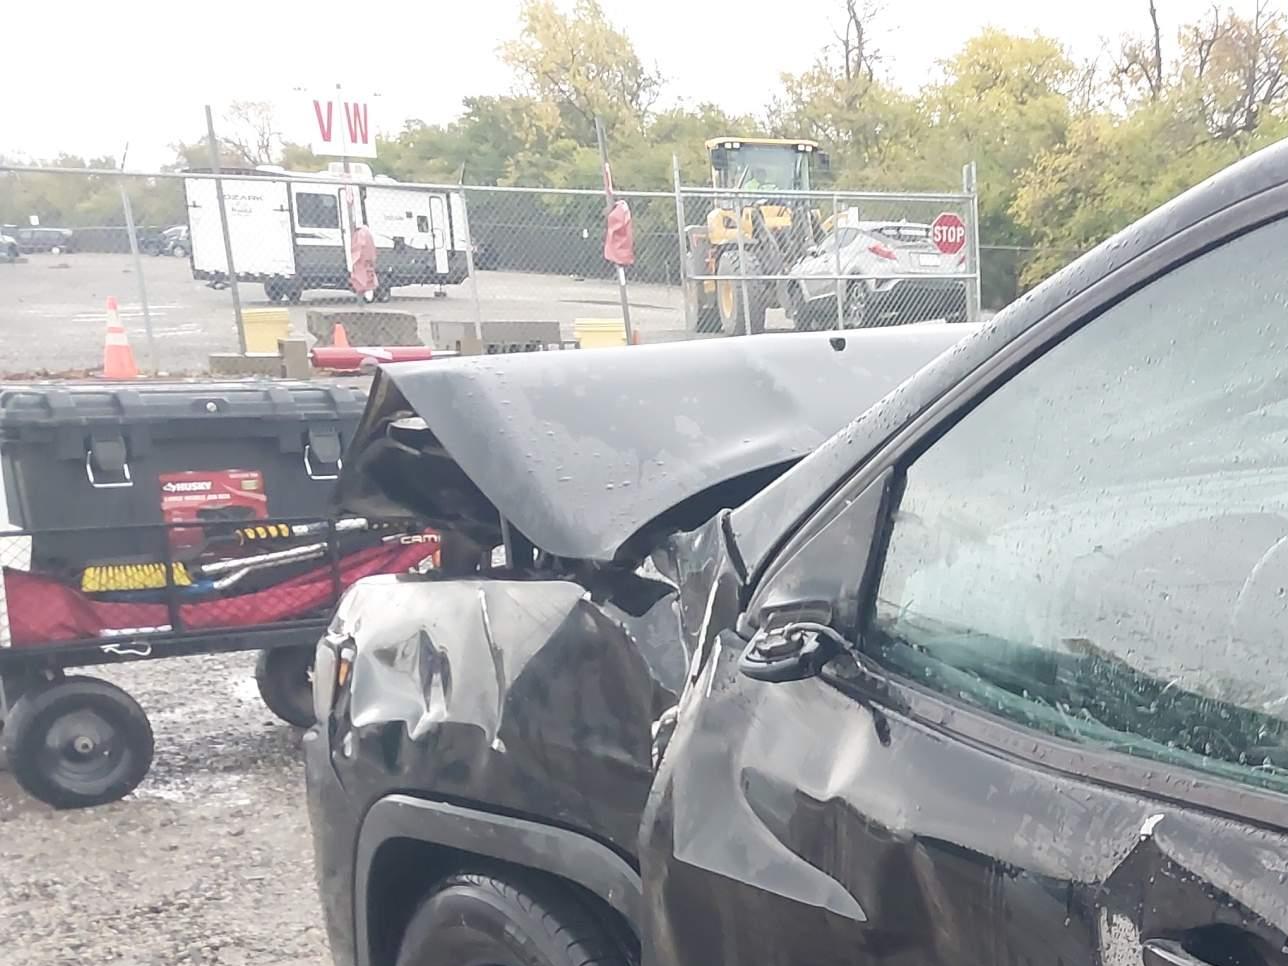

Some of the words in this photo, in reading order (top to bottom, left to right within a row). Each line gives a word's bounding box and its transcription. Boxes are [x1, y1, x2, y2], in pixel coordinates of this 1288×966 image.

[934, 225, 964, 243] STOP
[176, 481, 212, 491] HUSKY
[400, 534, 441, 544] CAM
